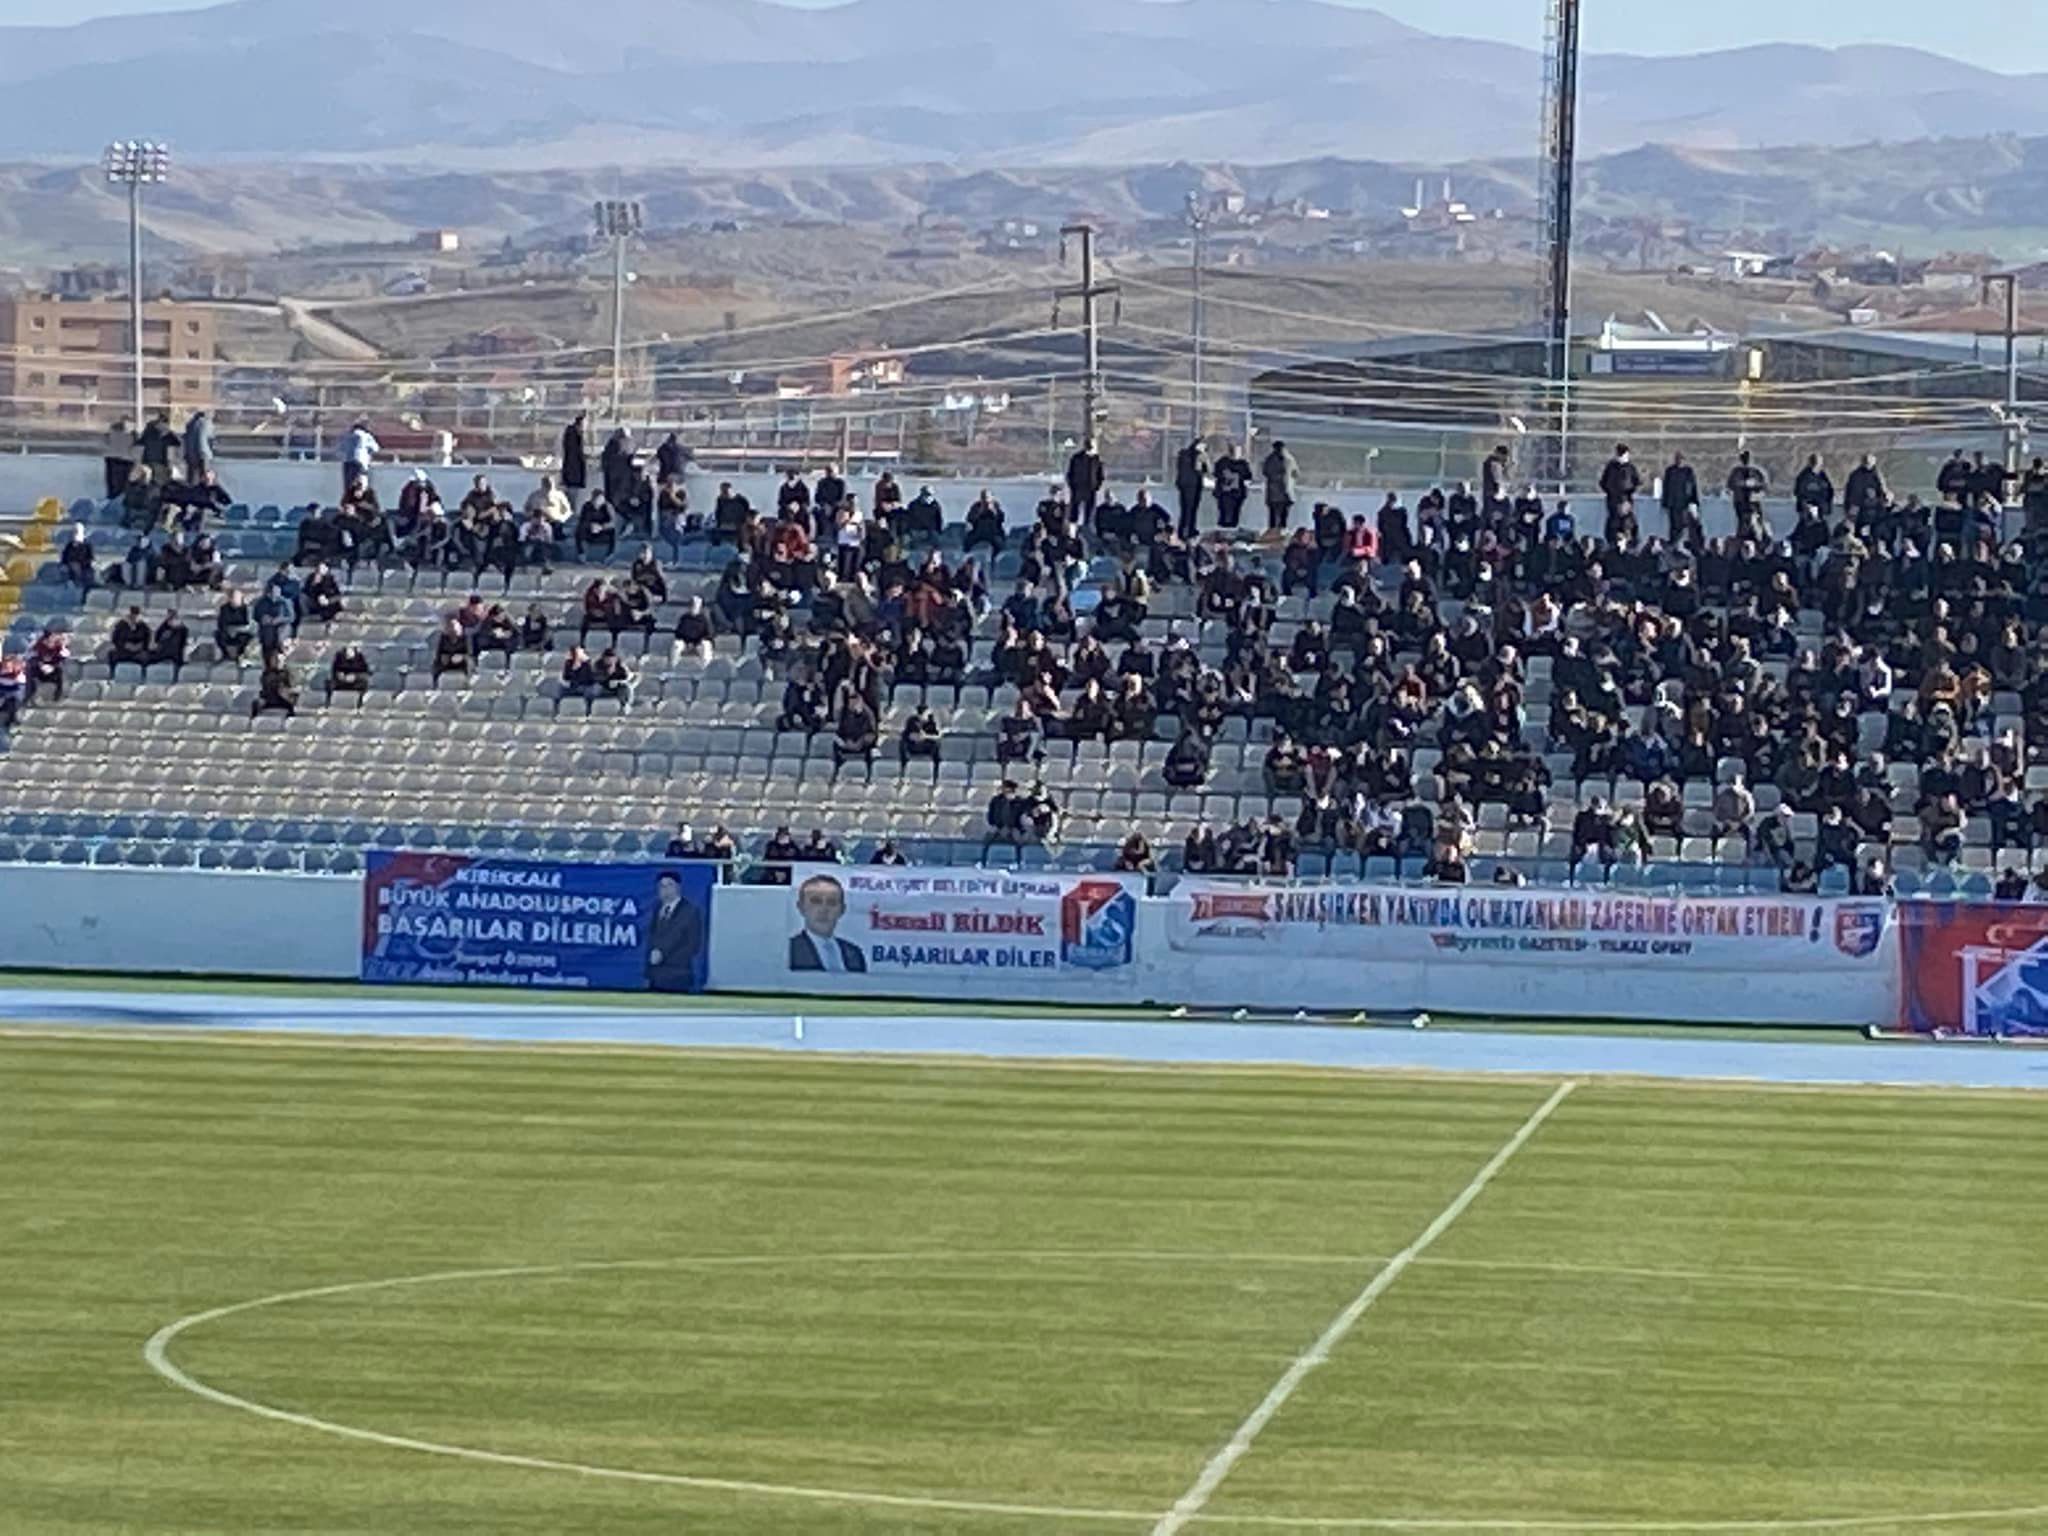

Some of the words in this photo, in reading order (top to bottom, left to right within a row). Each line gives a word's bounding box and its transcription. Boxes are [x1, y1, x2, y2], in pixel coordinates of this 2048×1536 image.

[379, 881, 450, 909] BÜYÜK
[532, 917, 637, 948] DİLERİM
[872, 944, 989, 968] BAŞARILAR
[995, 946, 1056, 969] DİLER
